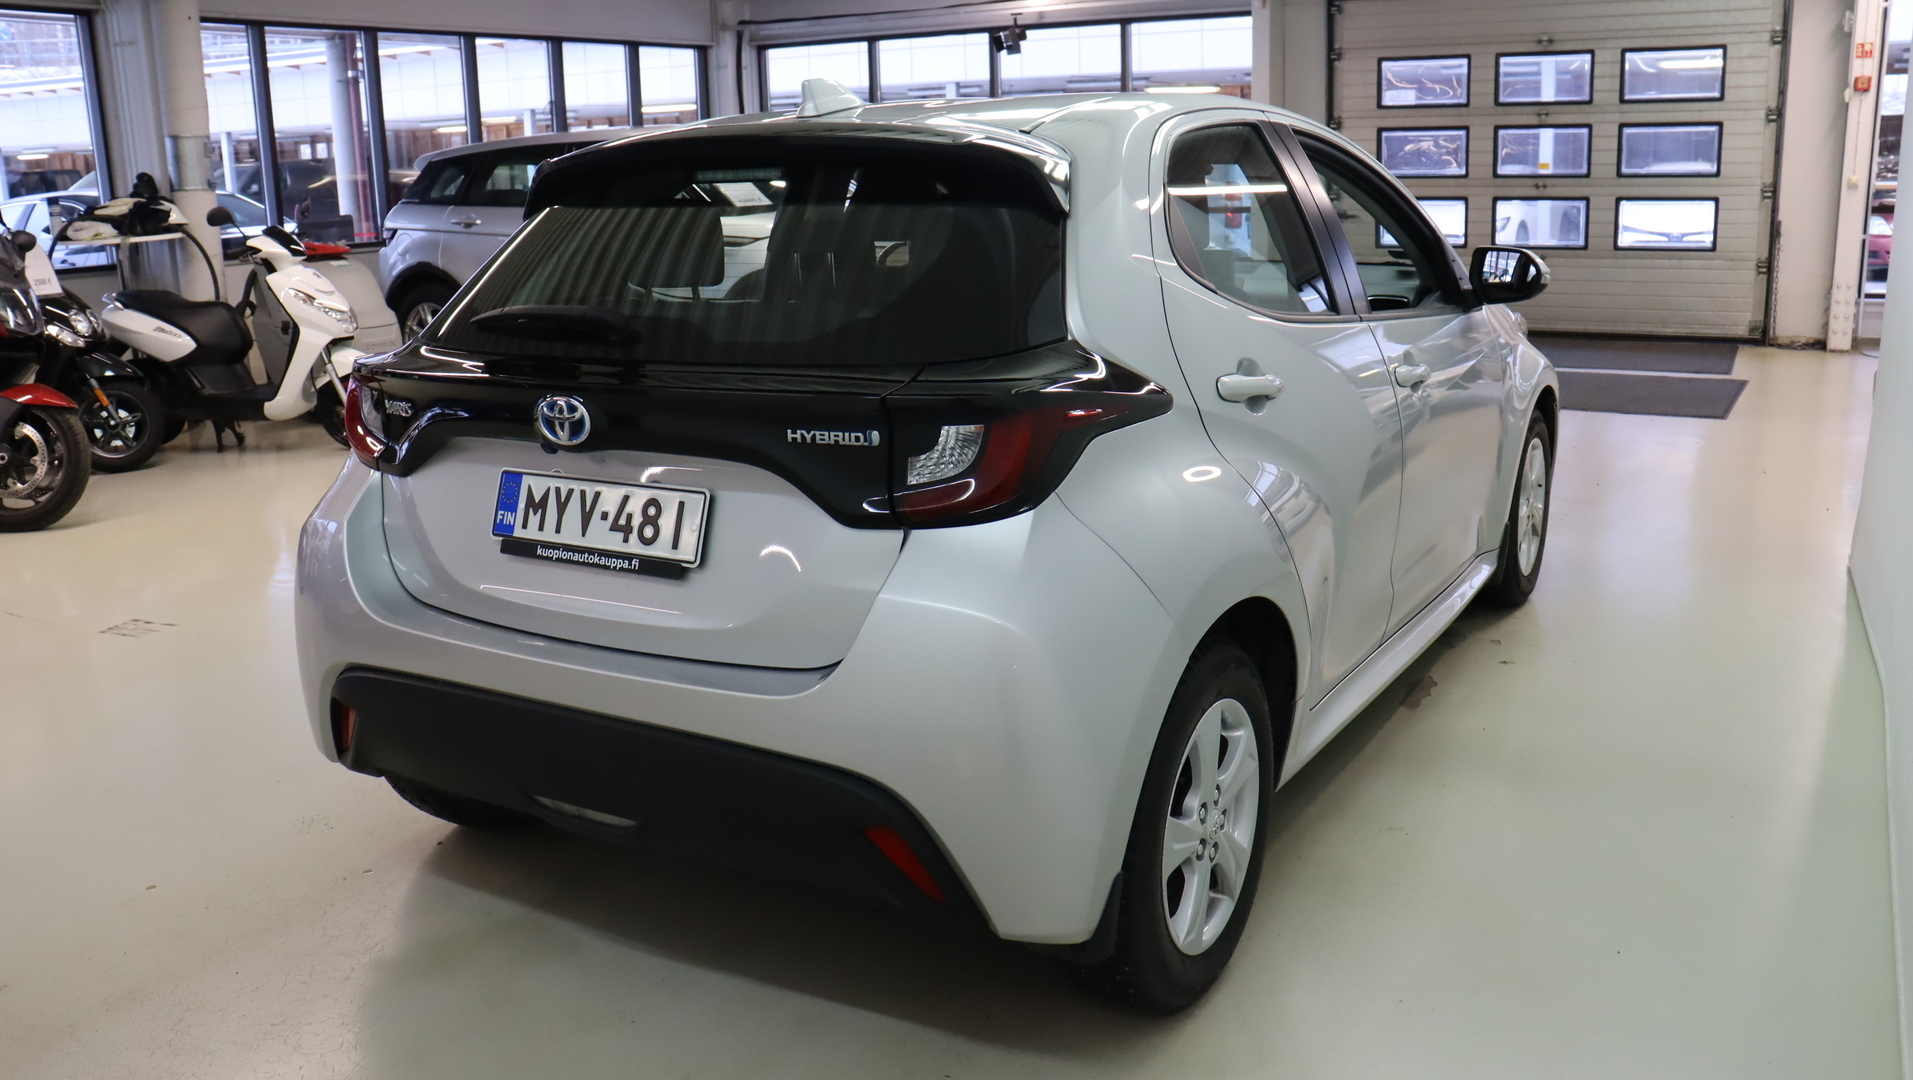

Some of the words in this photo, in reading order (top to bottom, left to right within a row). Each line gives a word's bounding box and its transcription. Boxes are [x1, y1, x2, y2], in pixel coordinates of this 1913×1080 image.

[786, 429, 864, 446] HYBRID
[496, 510, 516, 526] FIN
[521, 483, 686, 550] MYV-481
[536, 545, 640, 570] kuopionautokauppa.fi
